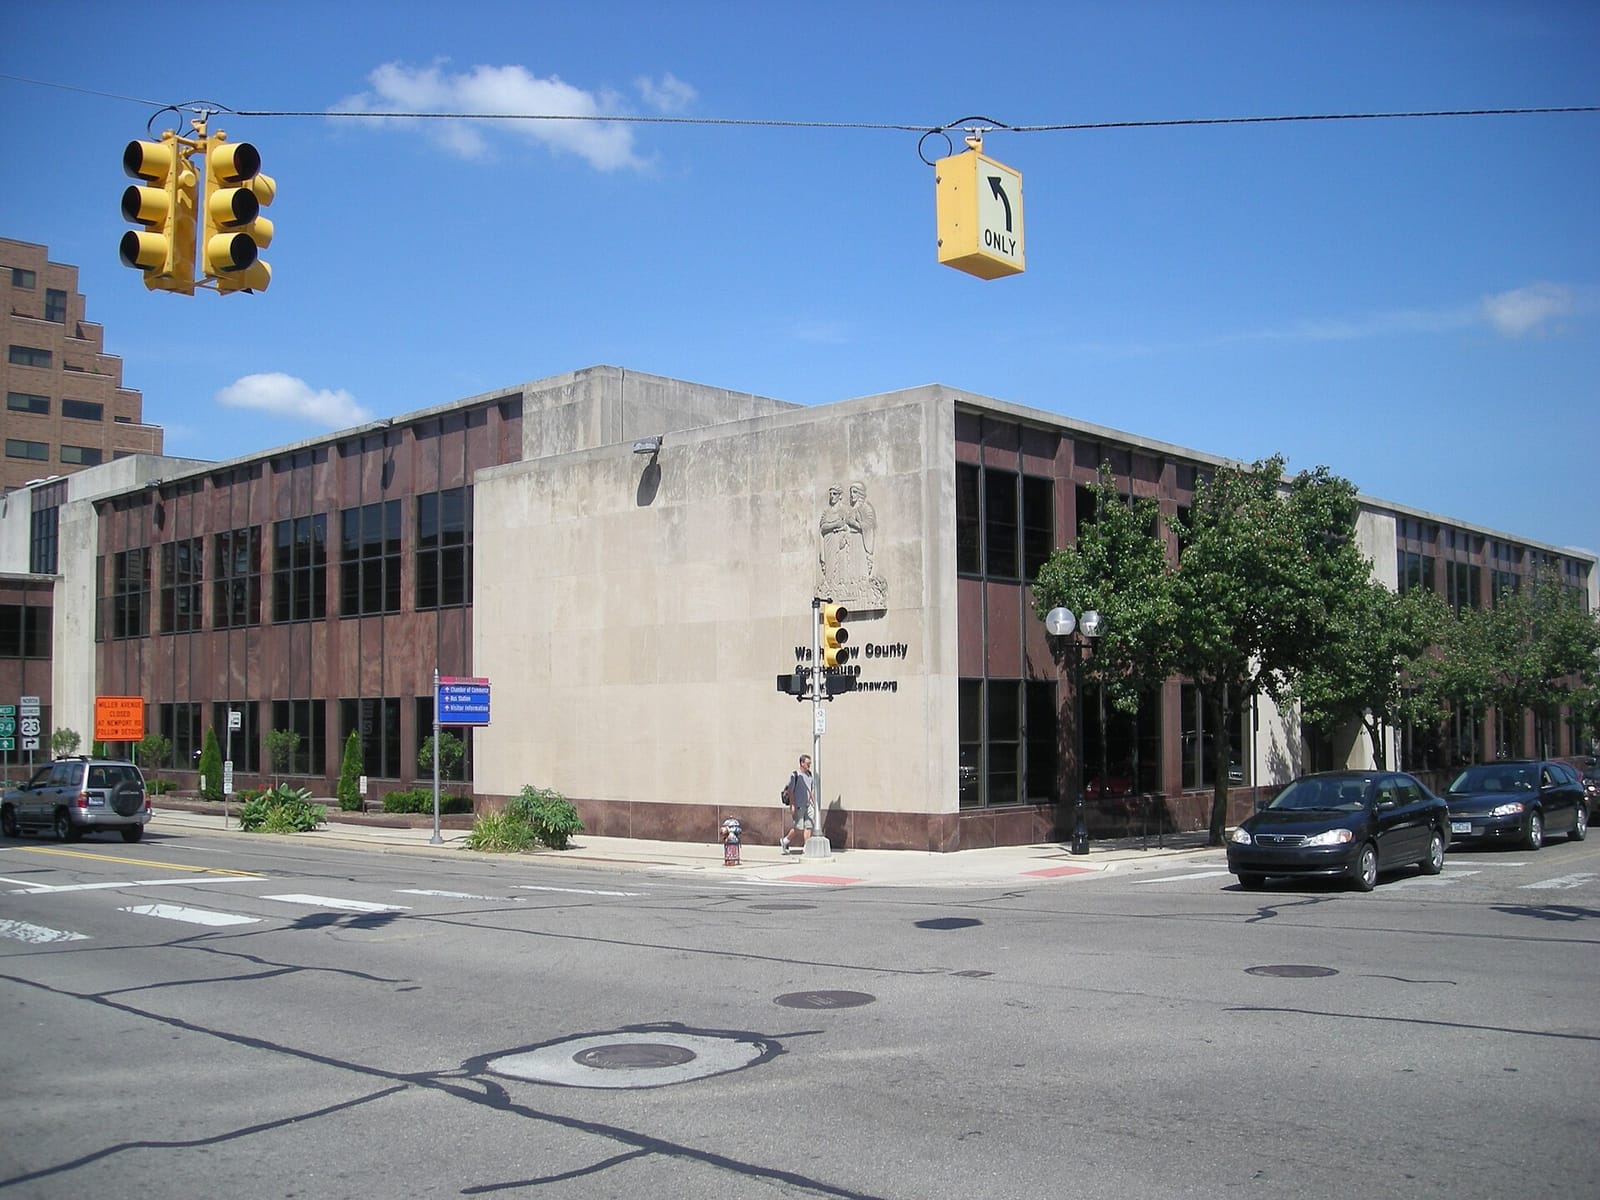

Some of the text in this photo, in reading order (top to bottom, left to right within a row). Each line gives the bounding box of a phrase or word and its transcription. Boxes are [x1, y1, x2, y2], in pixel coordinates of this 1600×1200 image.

[984, 228, 1016, 256] ONLY
[795, 642, 908, 661] Wahaw County
[795, 664, 861, 678] Cotouse
[0, 723, 12, 731] 94
[23, 721, 39, 732] 23
